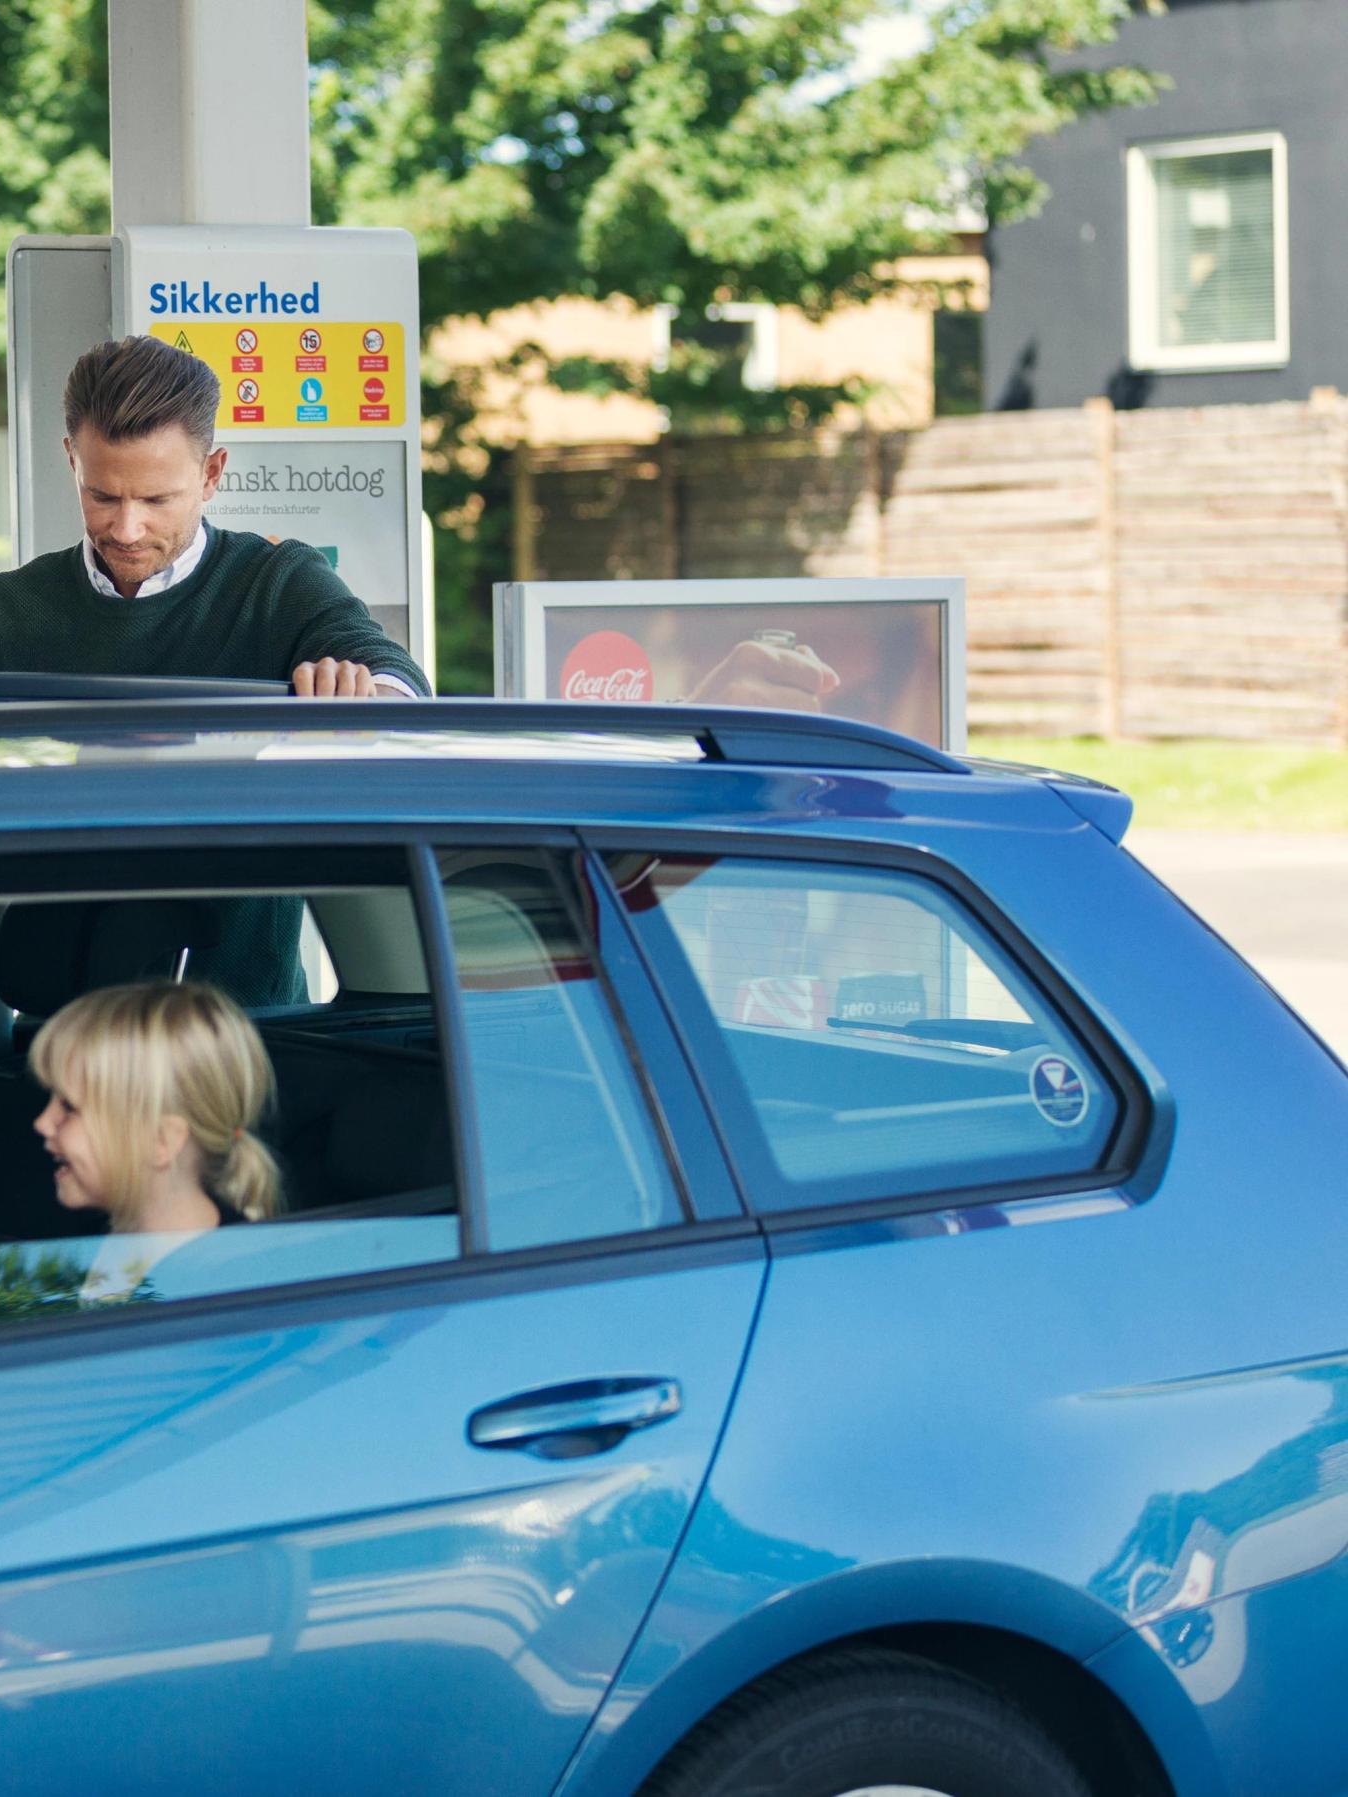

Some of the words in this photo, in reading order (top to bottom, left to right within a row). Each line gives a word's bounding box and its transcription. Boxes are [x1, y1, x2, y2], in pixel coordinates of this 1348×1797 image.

[149, 281, 320, 314] Sikkerhed
[302, 335, 318, 349] 15
[285, 464, 385, 498] hotdog
[219, 504, 261, 515] cheddar
[262, 503, 321, 515] frankfurter
[565, 668, 648, 701] Coca-Cola
[841, 1001, 876, 1019] zero
